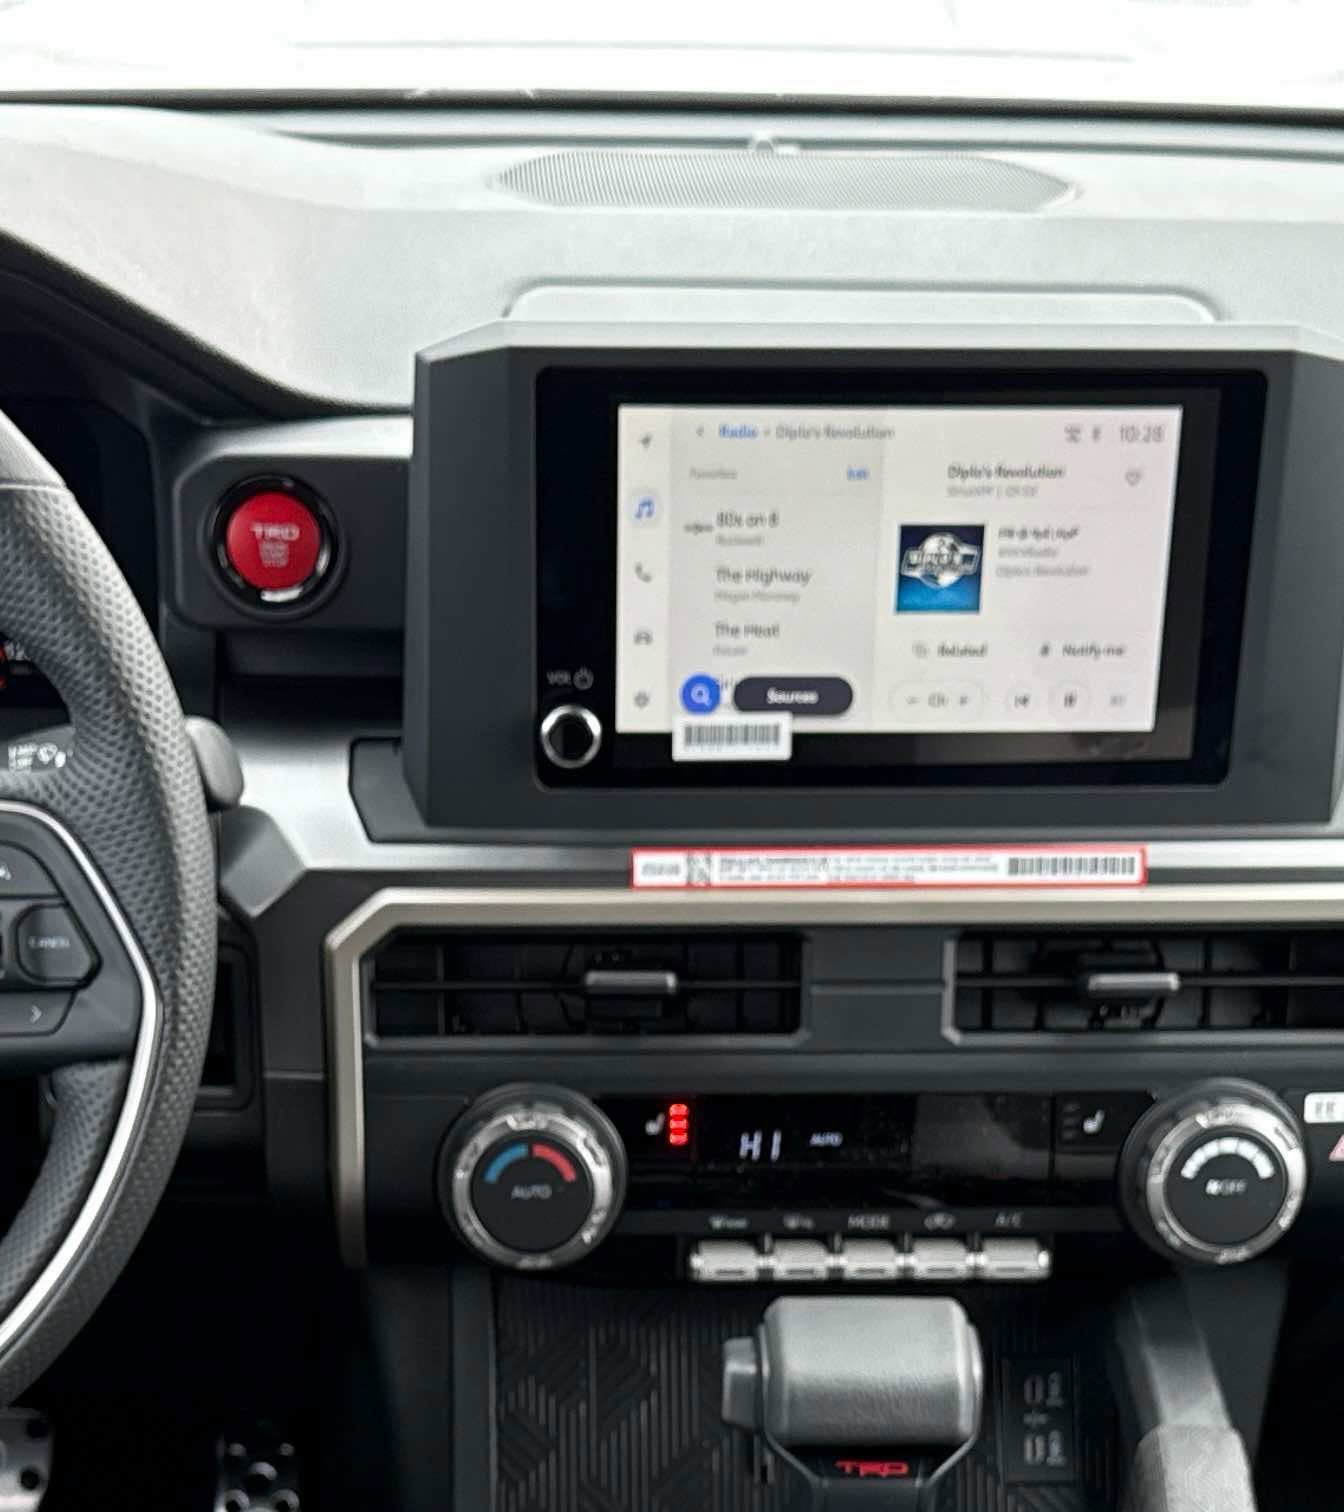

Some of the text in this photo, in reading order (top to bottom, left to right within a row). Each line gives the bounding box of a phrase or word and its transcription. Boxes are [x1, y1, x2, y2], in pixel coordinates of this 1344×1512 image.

[511, 1184, 553, 1199] AUTO
[847, 1214, 890, 1230] MODE
[994, 1212, 1023, 1228] A/C
[834, 1458, 911, 1478] TRD
